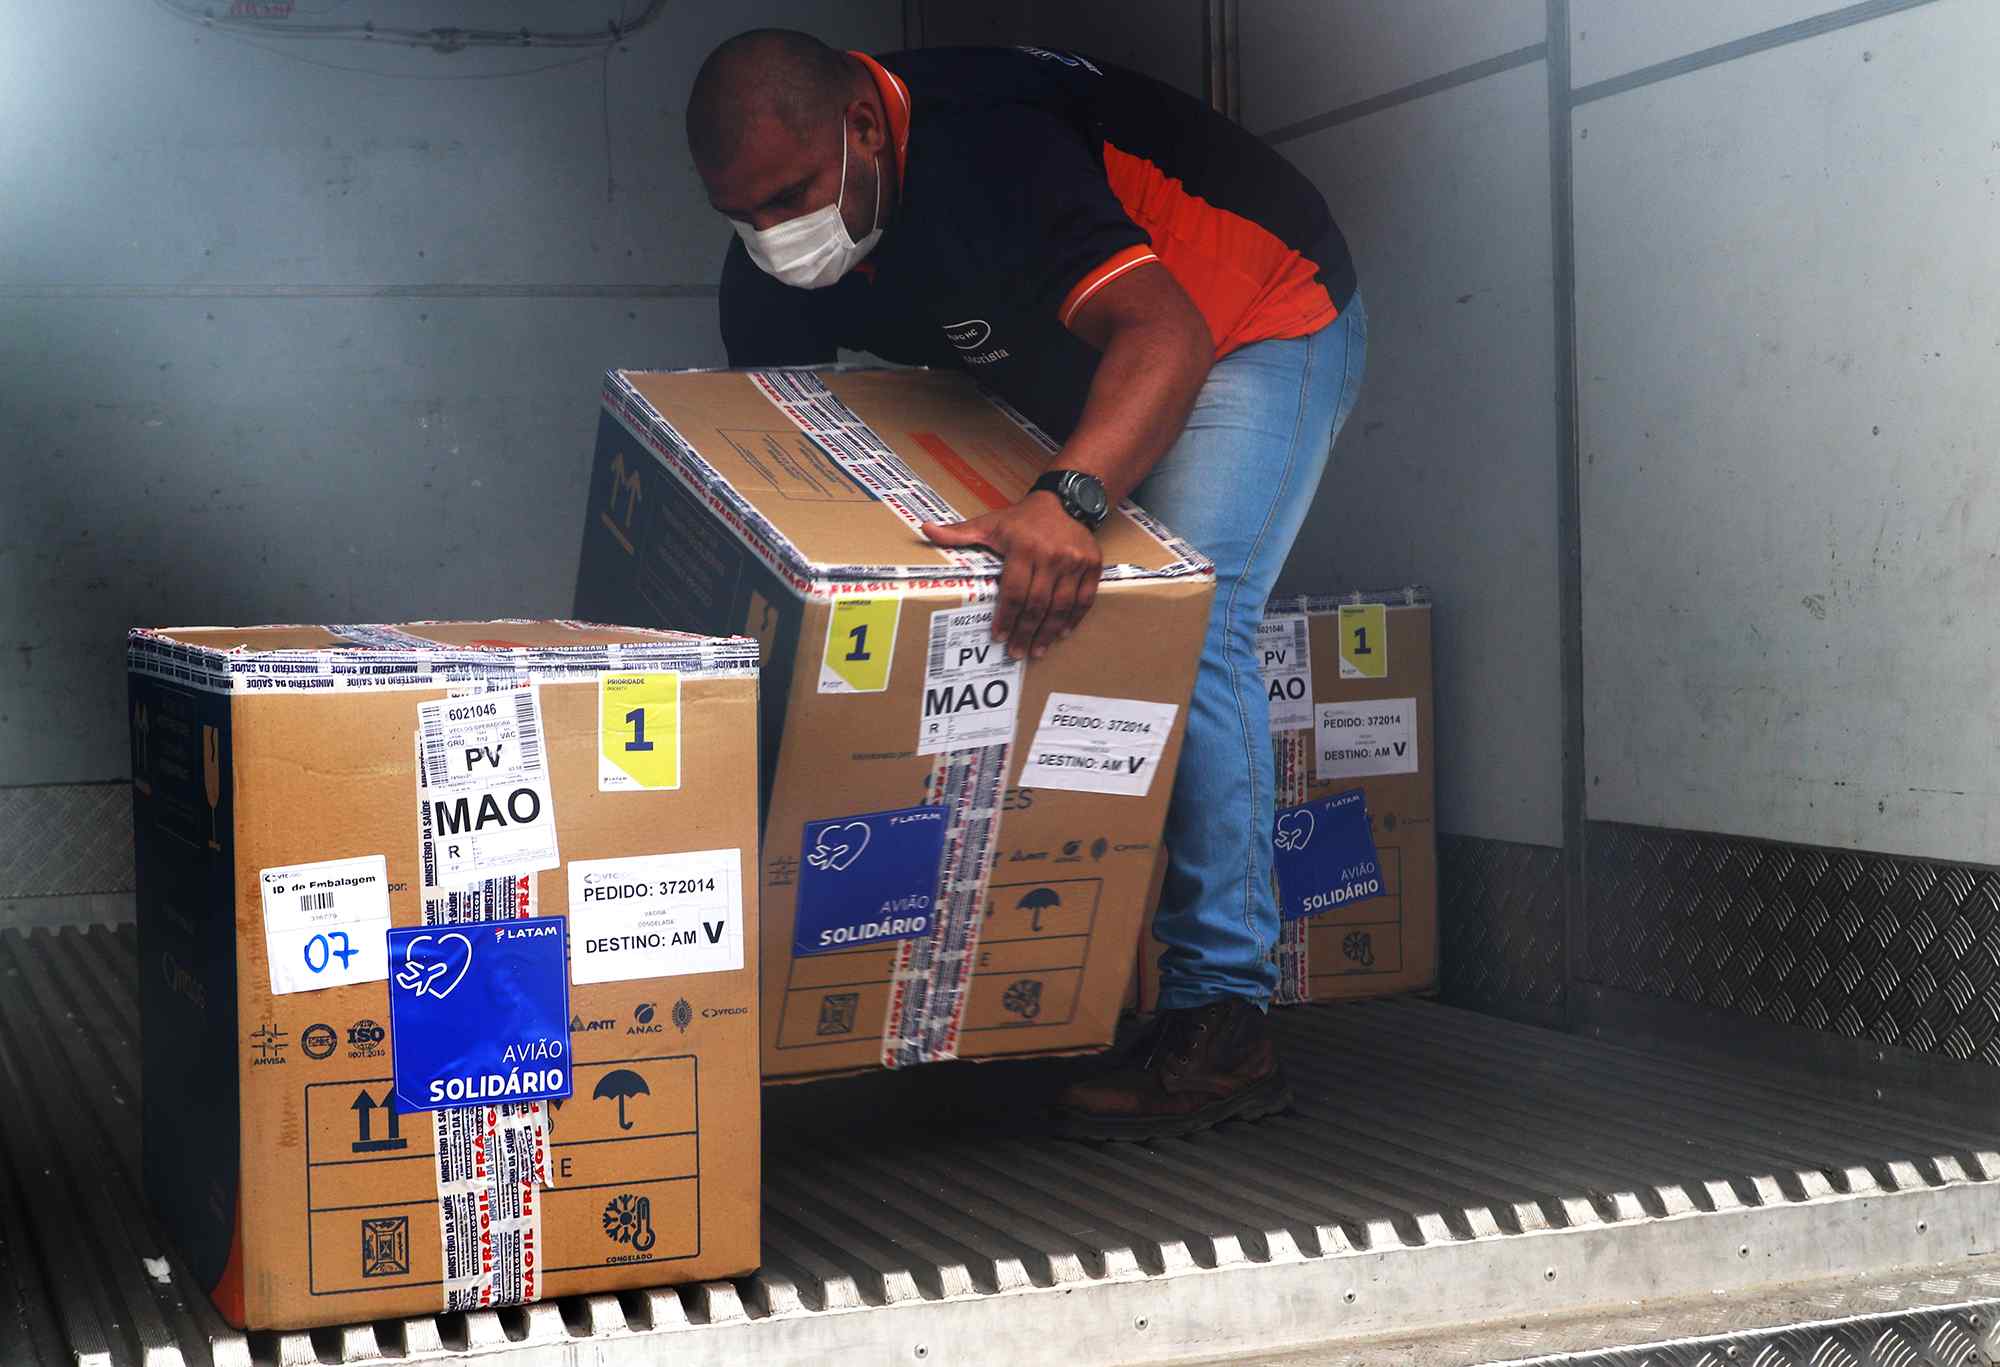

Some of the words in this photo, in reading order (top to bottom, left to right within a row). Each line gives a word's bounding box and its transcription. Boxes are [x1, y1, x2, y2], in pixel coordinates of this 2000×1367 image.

[845, 624, 871, 662] 1
[1354, 627, 1372, 655] 1
[958, 645, 990, 667] PV
[1264, 650, 1286, 666] PV
[258, 664, 271, 673] DA
[359, 665, 370, 673] DA
[275, 679, 286, 688] DA
[288, 679, 334, 688] MINISTÉRIO
[1268, 676, 1306, 702] AO
[924, 679, 1009, 717] MAO
[450, 704, 497, 721] 6021046
[1052, 714, 1104, 730] PEDIDO:
[1324, 718, 1364, 729] PEDIDO:
[1367, 716, 1401, 726] 372014
[625, 708, 654, 752] 1
[930, 723, 940, 734] R
[465, 744, 503, 772] PV
[1324, 749, 1372, 762] DESTINO:
[1374, 748, 1391, 758] AM
[1393, 741, 1407, 757] V
[1128, 756, 1145, 774] V
[422, 800, 431, 826] SAÚDE
[434, 788, 541, 837] MAO
[424, 829, 433, 840] DA
[448, 845, 461, 859] R
[424, 842, 434, 887] MINISTÉRIO
[1340, 861, 1376, 882] AVIÃO
[273, 885, 285, 894] ID
[584, 883, 654, 902] PEDIDO:
[660, 878, 716, 896] 372014
[1303, 880, 1379, 912] SOLIDÁRIO
[880, 896, 930, 915] AVIÃO
[508, 926, 558, 939] LATAM
[586, 934, 666, 954] DESTINO:
[671, 930, 698, 946] AM
[703, 920, 724, 944] V
[820, 916, 926, 946] SOLIDÁRIO
[304, 932, 360, 974] 07
[347, 1027, 385, 1044] ISO
[626, 1024, 664, 1036] ANAC
[502, 1038, 562, 1064] AVIÃO
[430, 1066, 564, 1102] SOLIDÁRIO
[439, 1125, 448, 1136] DA
[504, 1128, 514, 1154] SAÚDE
[440, 1138, 450, 1182] MINISTÉRIO
[534, 1126, 545, 1180] ÁGIL
[443, 1195, 453, 1220] SAÚDE
[446, 1222, 455, 1234] DA
[479, 1189, 492, 1272] FRÁGIL
[447, 1236, 457, 1278] MINISTÉRIO
[449, 1290, 458, 1310] AÚDE
